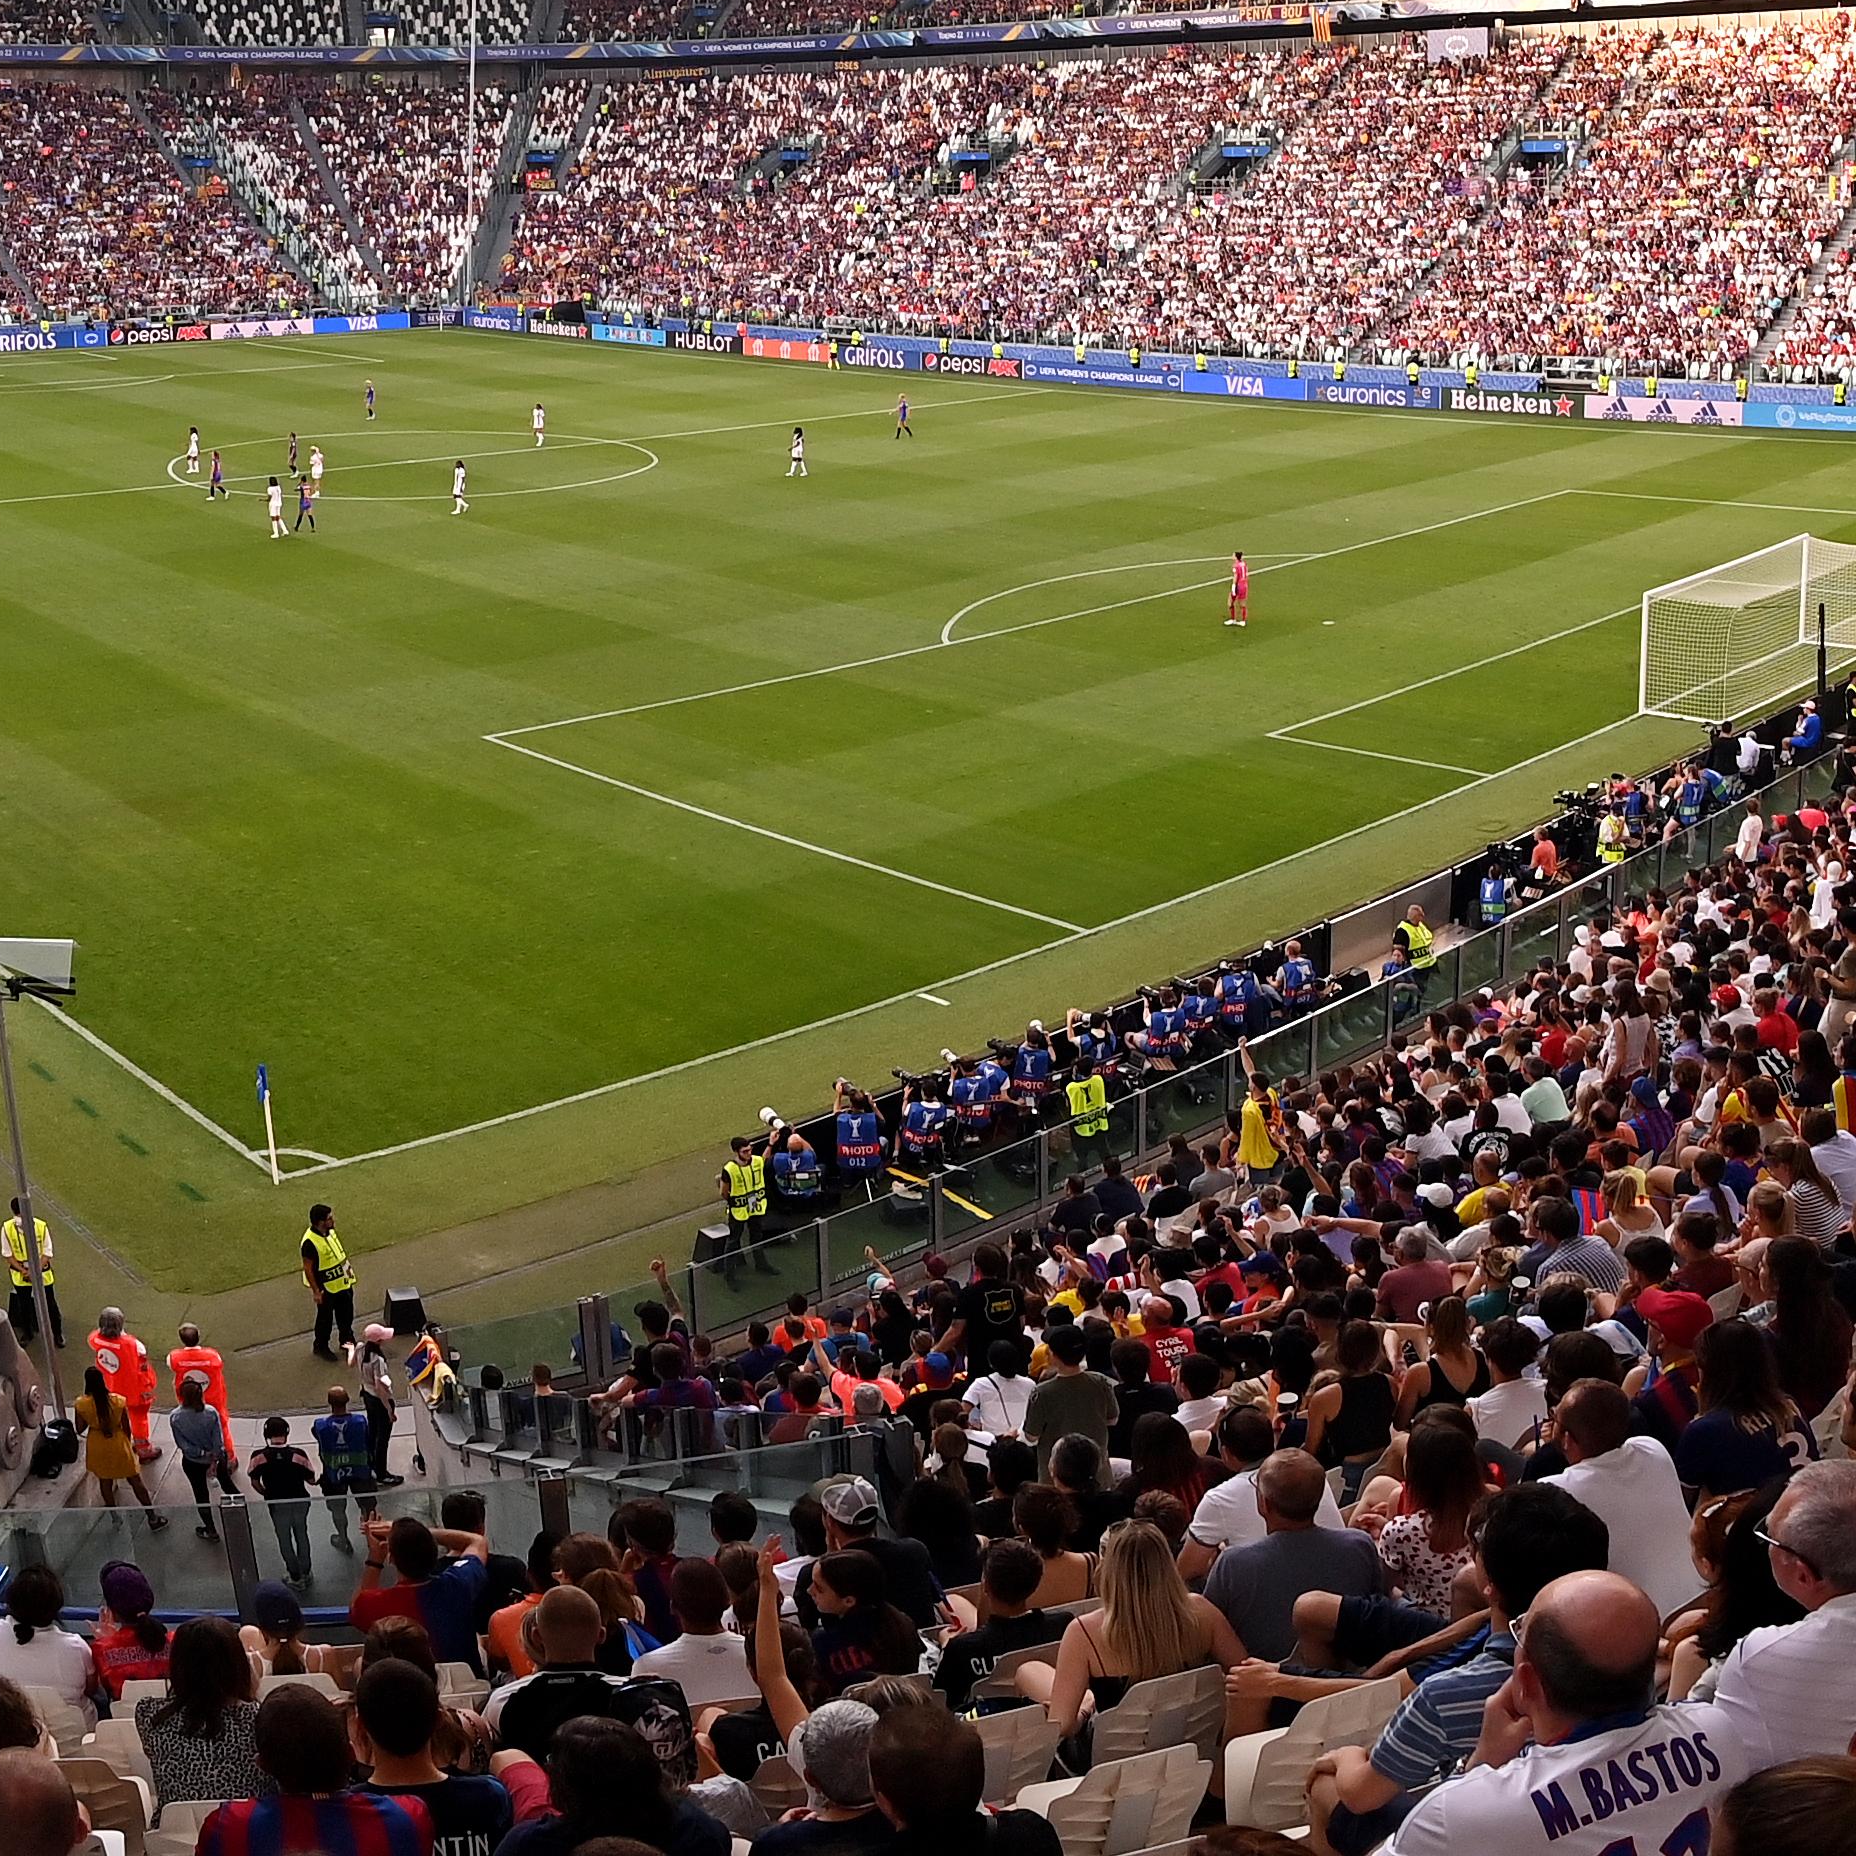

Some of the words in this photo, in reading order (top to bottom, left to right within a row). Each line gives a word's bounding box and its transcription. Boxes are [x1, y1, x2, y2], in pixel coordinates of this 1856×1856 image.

[16, 48, 44, 57] FINAL
[198, 51, 215, 59] UEFA
[250, 50, 294, 59] CHAMPIONS
[296, 50, 323, 59] LEAGUE
[705, 43, 722, 53] UEFA
[346, 315, 378, 330] VISA
[473, 316, 511, 331] euronics
[529, 319, 578, 339] Heineken
[128, 325, 173, 345] pepsi
[175, 326, 208, 340] MAX
[675, 332, 733, 352] HUBLOT
[845, 346, 905, 370] GRIFOLS
[940, 353, 985, 375] pepsi
[987, 358, 1020, 378] MAX
[1039, 366, 1055, 375] UEFA
[1090, 370, 1133, 382] CHAMPIONS
[1134, 373, 1163, 384] LEAGUE
[1224, 375, 1264, 394] VISA
[1326, 385, 1406, 406] euronics
[1450, 389, 1552, 414] Heineken
[1602, 411, 1632, 421] adidas
[1646, 412, 1677, 423] adidas
[1691, 414, 1723, 425] adidas
[1013, 1078, 1045, 1091] PHOTO
[841, 1145, 874, 1156] PHOTO
[849, 1157, 866, 1167] 012
[1156, 1336, 1184, 1349] CYRIL
[1156, 1345, 1189, 1359] TOURS
[1530, 1730, 1722, 1842] M.BASTOS
